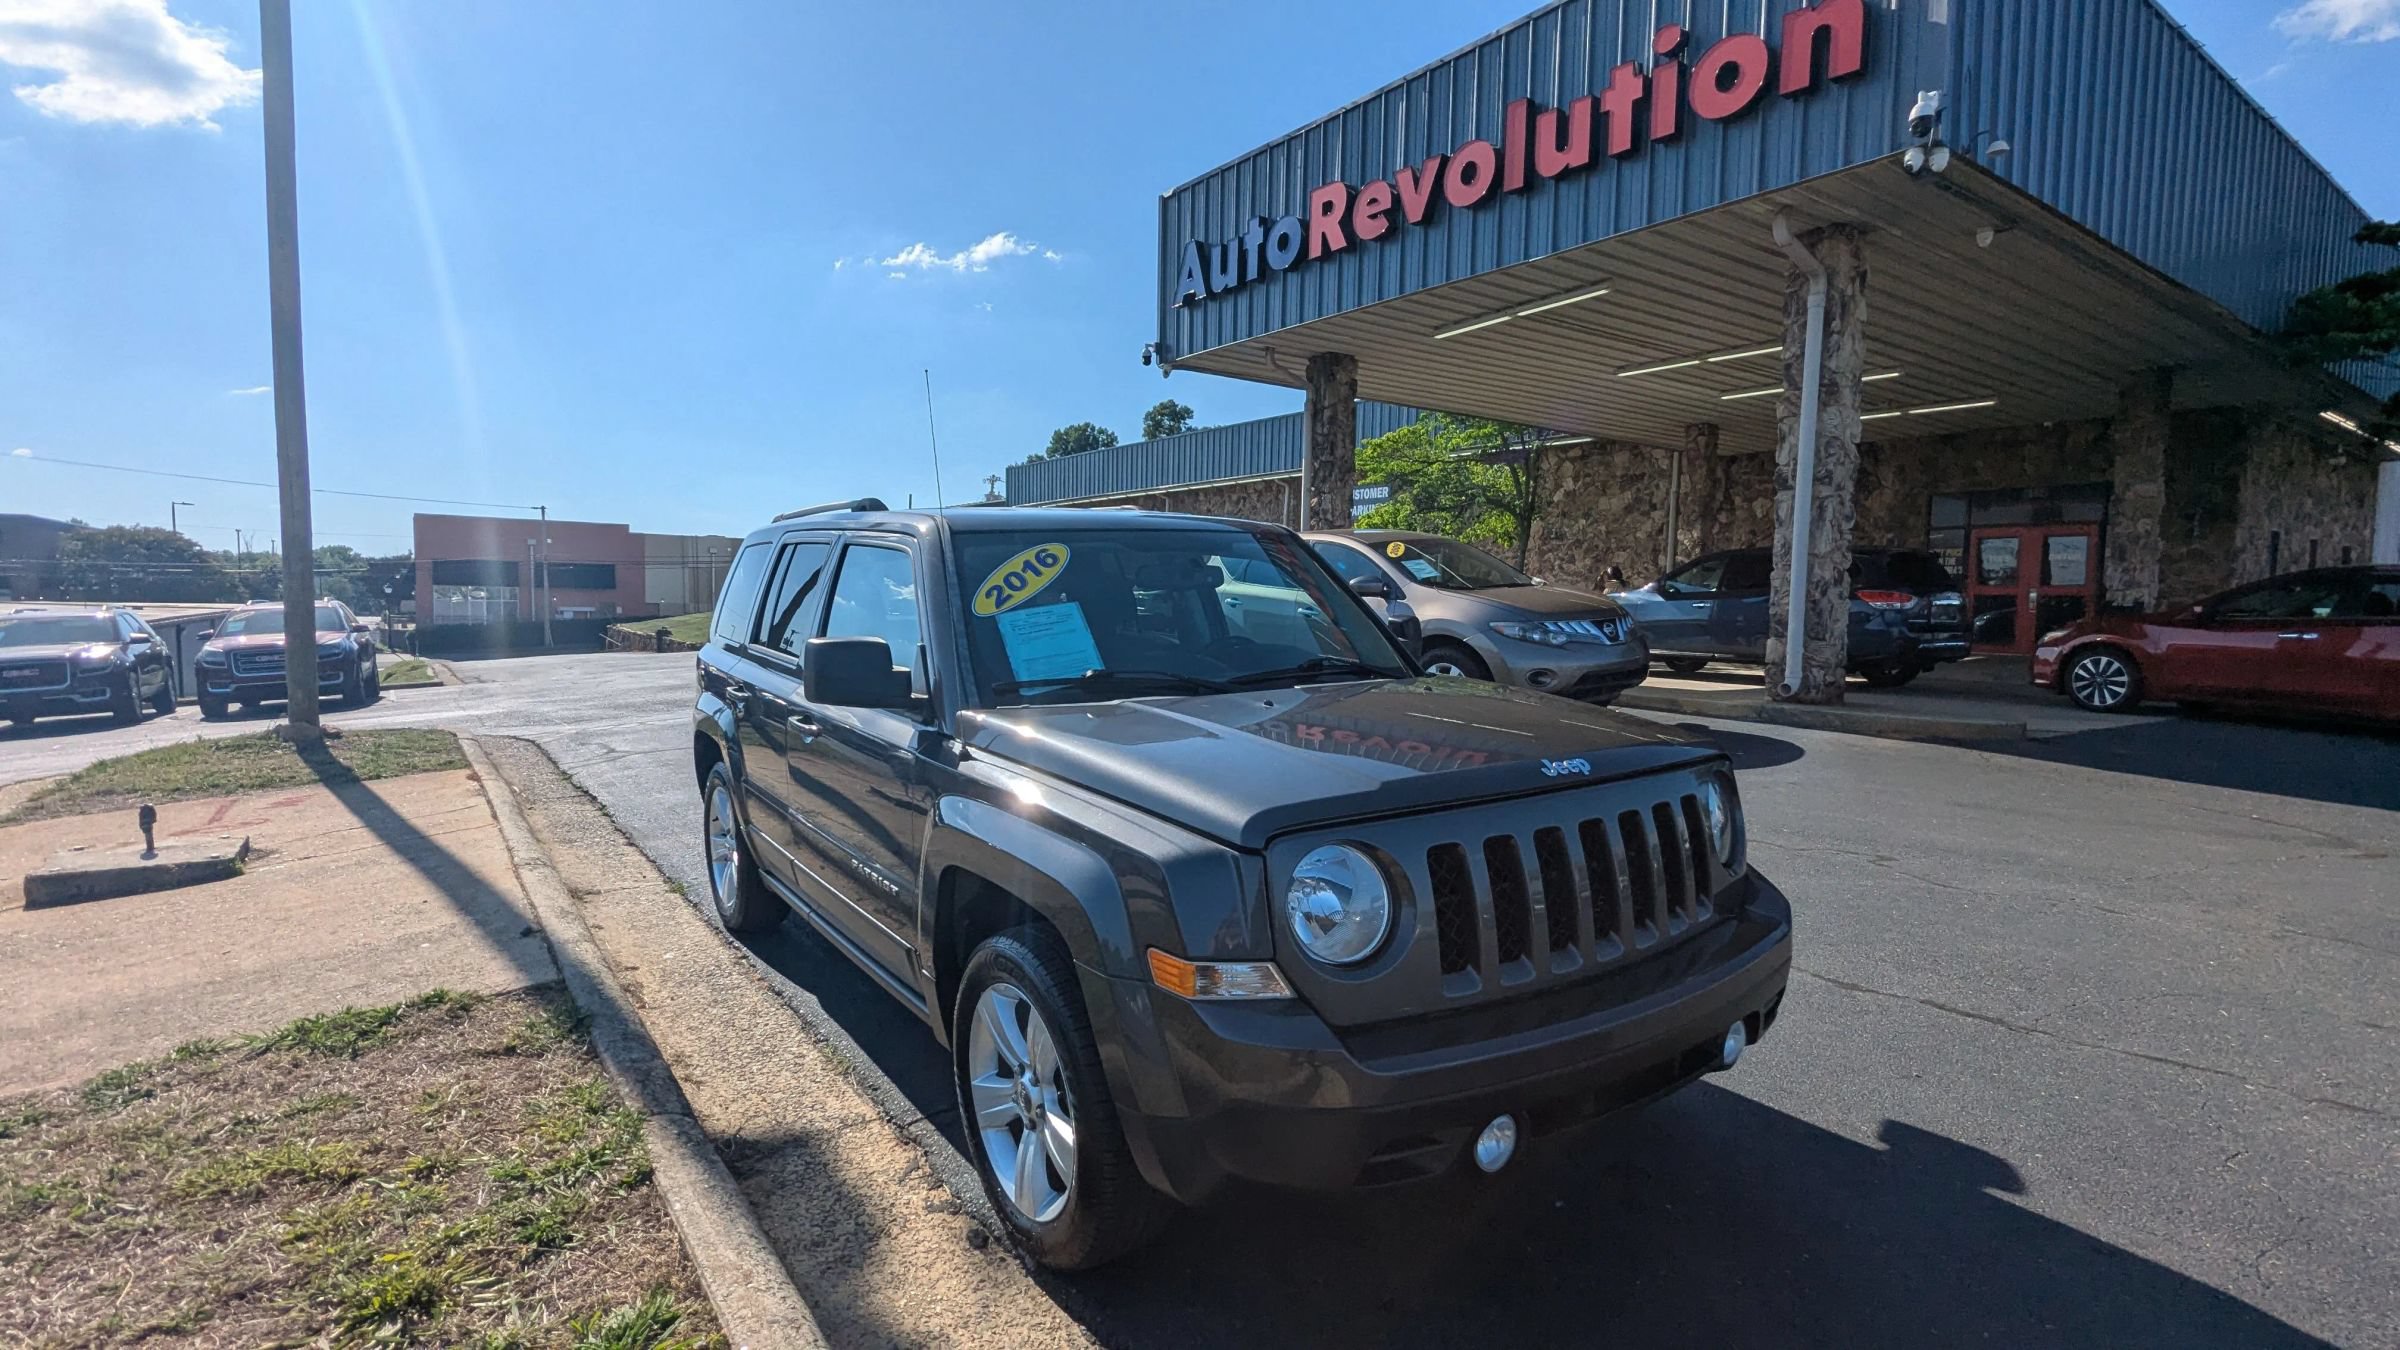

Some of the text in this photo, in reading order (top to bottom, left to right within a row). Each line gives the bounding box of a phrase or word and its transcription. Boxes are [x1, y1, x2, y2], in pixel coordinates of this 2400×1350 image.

[1353, 487, 1389, 500] STOMER
[1350, 504, 1378, 517] ARKI
[985, 548, 1060, 609] 2016
[1540, 758, 1591, 777] Jeep
[851, 859, 899, 896] PATRIOT
